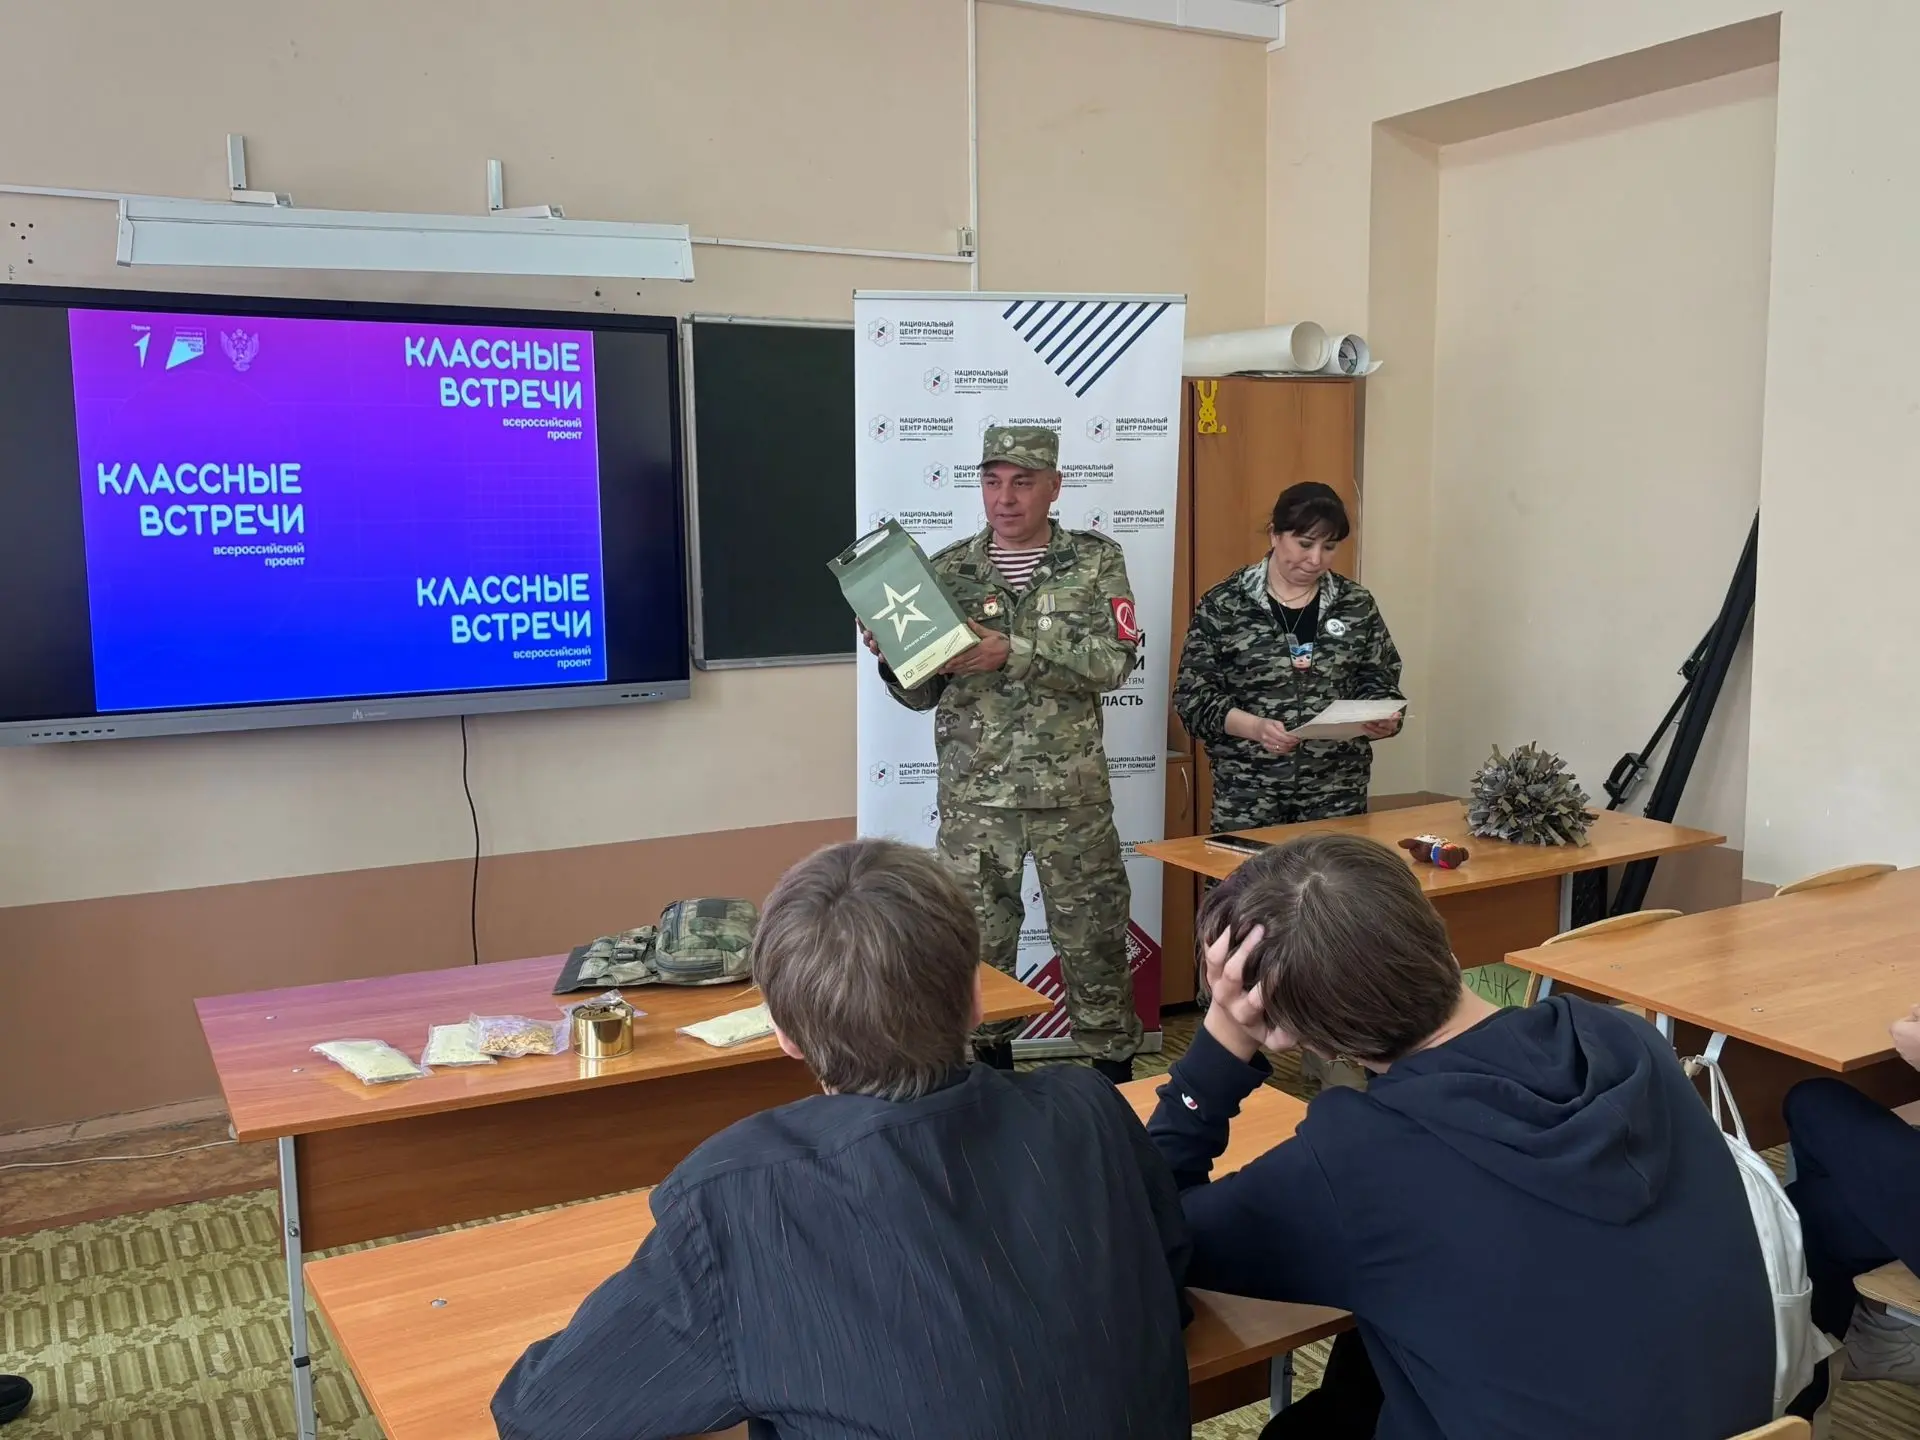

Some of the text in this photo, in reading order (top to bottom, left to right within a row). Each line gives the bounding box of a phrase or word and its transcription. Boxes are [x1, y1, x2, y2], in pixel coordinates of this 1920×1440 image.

[405, 336, 580, 372] КЛАССНЫЕ
[440, 376, 582, 410] ВСТРЕЧИ
[503, 417, 582, 429] всероссийский
[547, 431, 582, 440] проект
[97, 462, 303, 495] КЛАССНЫЕ
[139, 503, 305, 537] ВСТРЕЧИ
[213, 542, 304, 556] всероссийский
[265, 557, 305, 568] проект
[416, 573, 591, 607] КЛАССНЫЕ
[451, 610, 592, 644] ВСТРЕЧИ
[513, 645, 592, 660] всероссийский
[557, 660, 592, 669] проект
[1101, 695, 1143, 706] ЛАСТЬ
